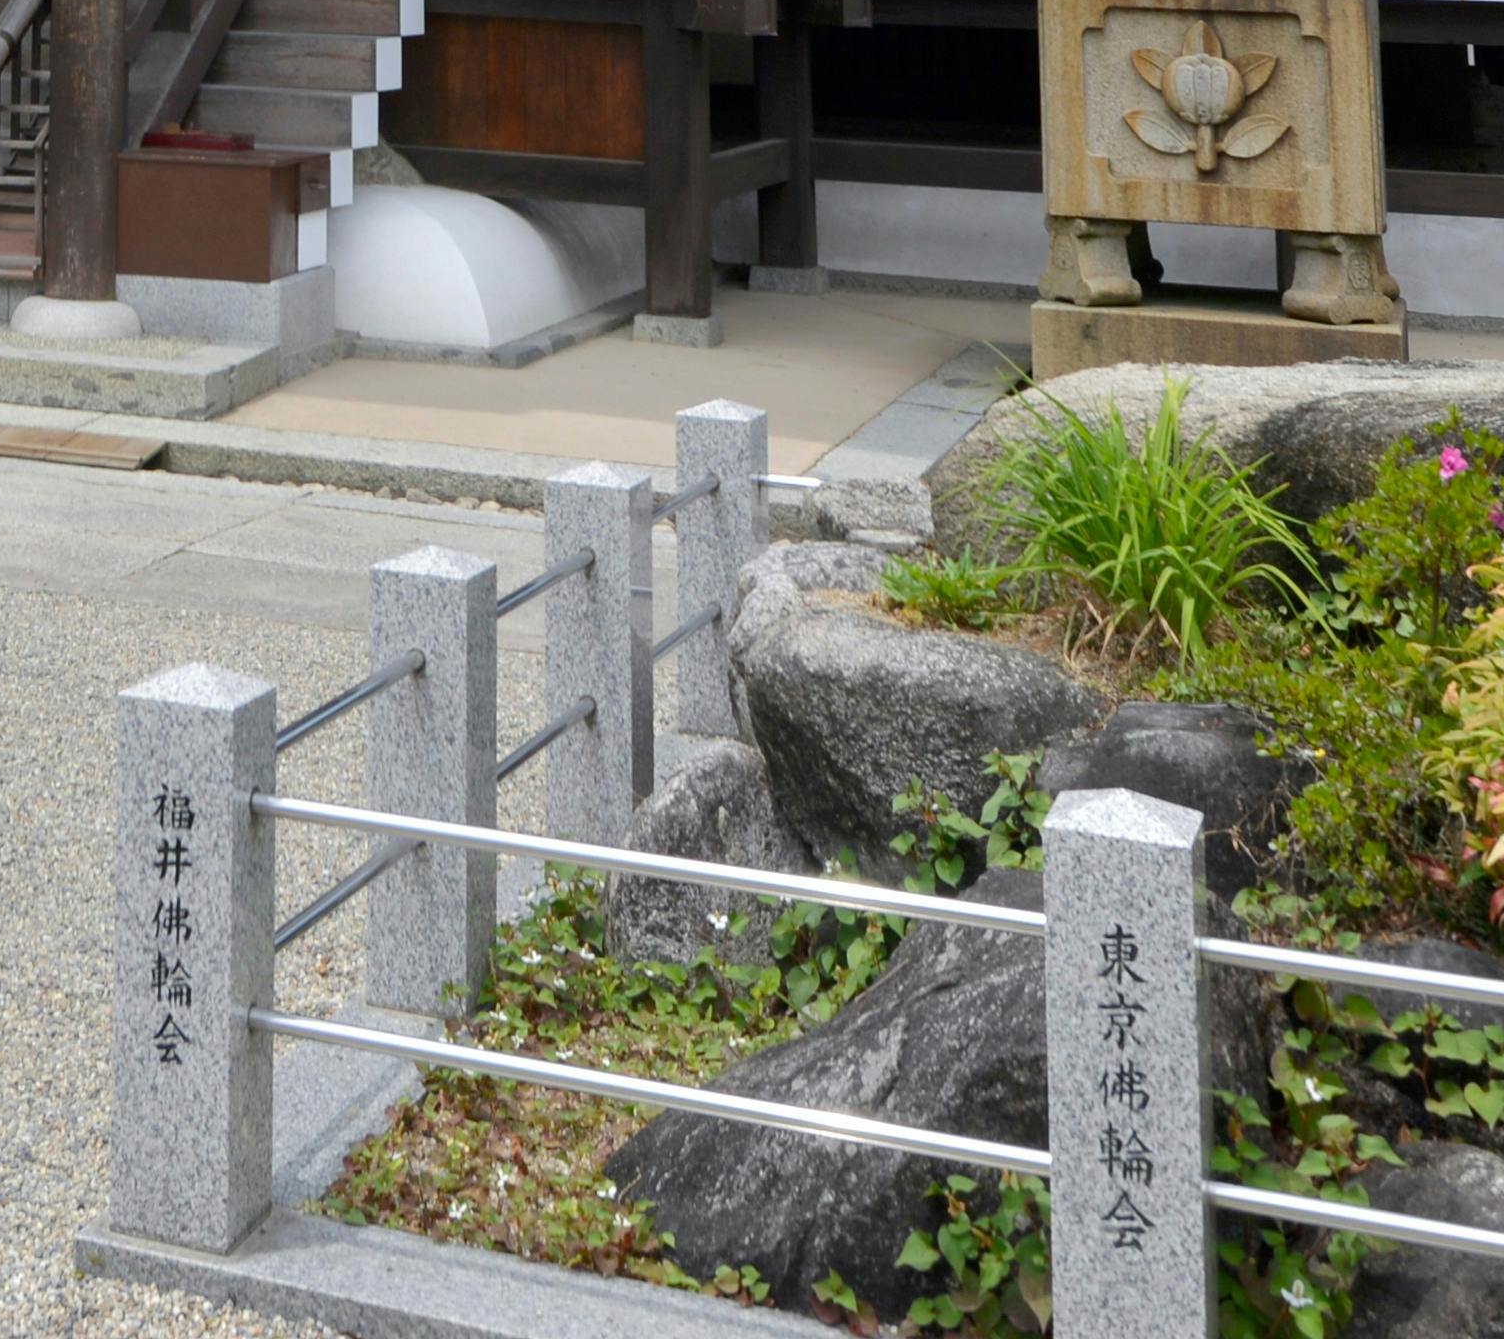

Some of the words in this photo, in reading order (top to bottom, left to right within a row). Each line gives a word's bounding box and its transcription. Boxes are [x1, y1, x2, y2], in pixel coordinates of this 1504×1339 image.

[151, 782, 195, 1066] 福井佛輪会
[1097, 923, 1155, 1252] 東京佛輪会
